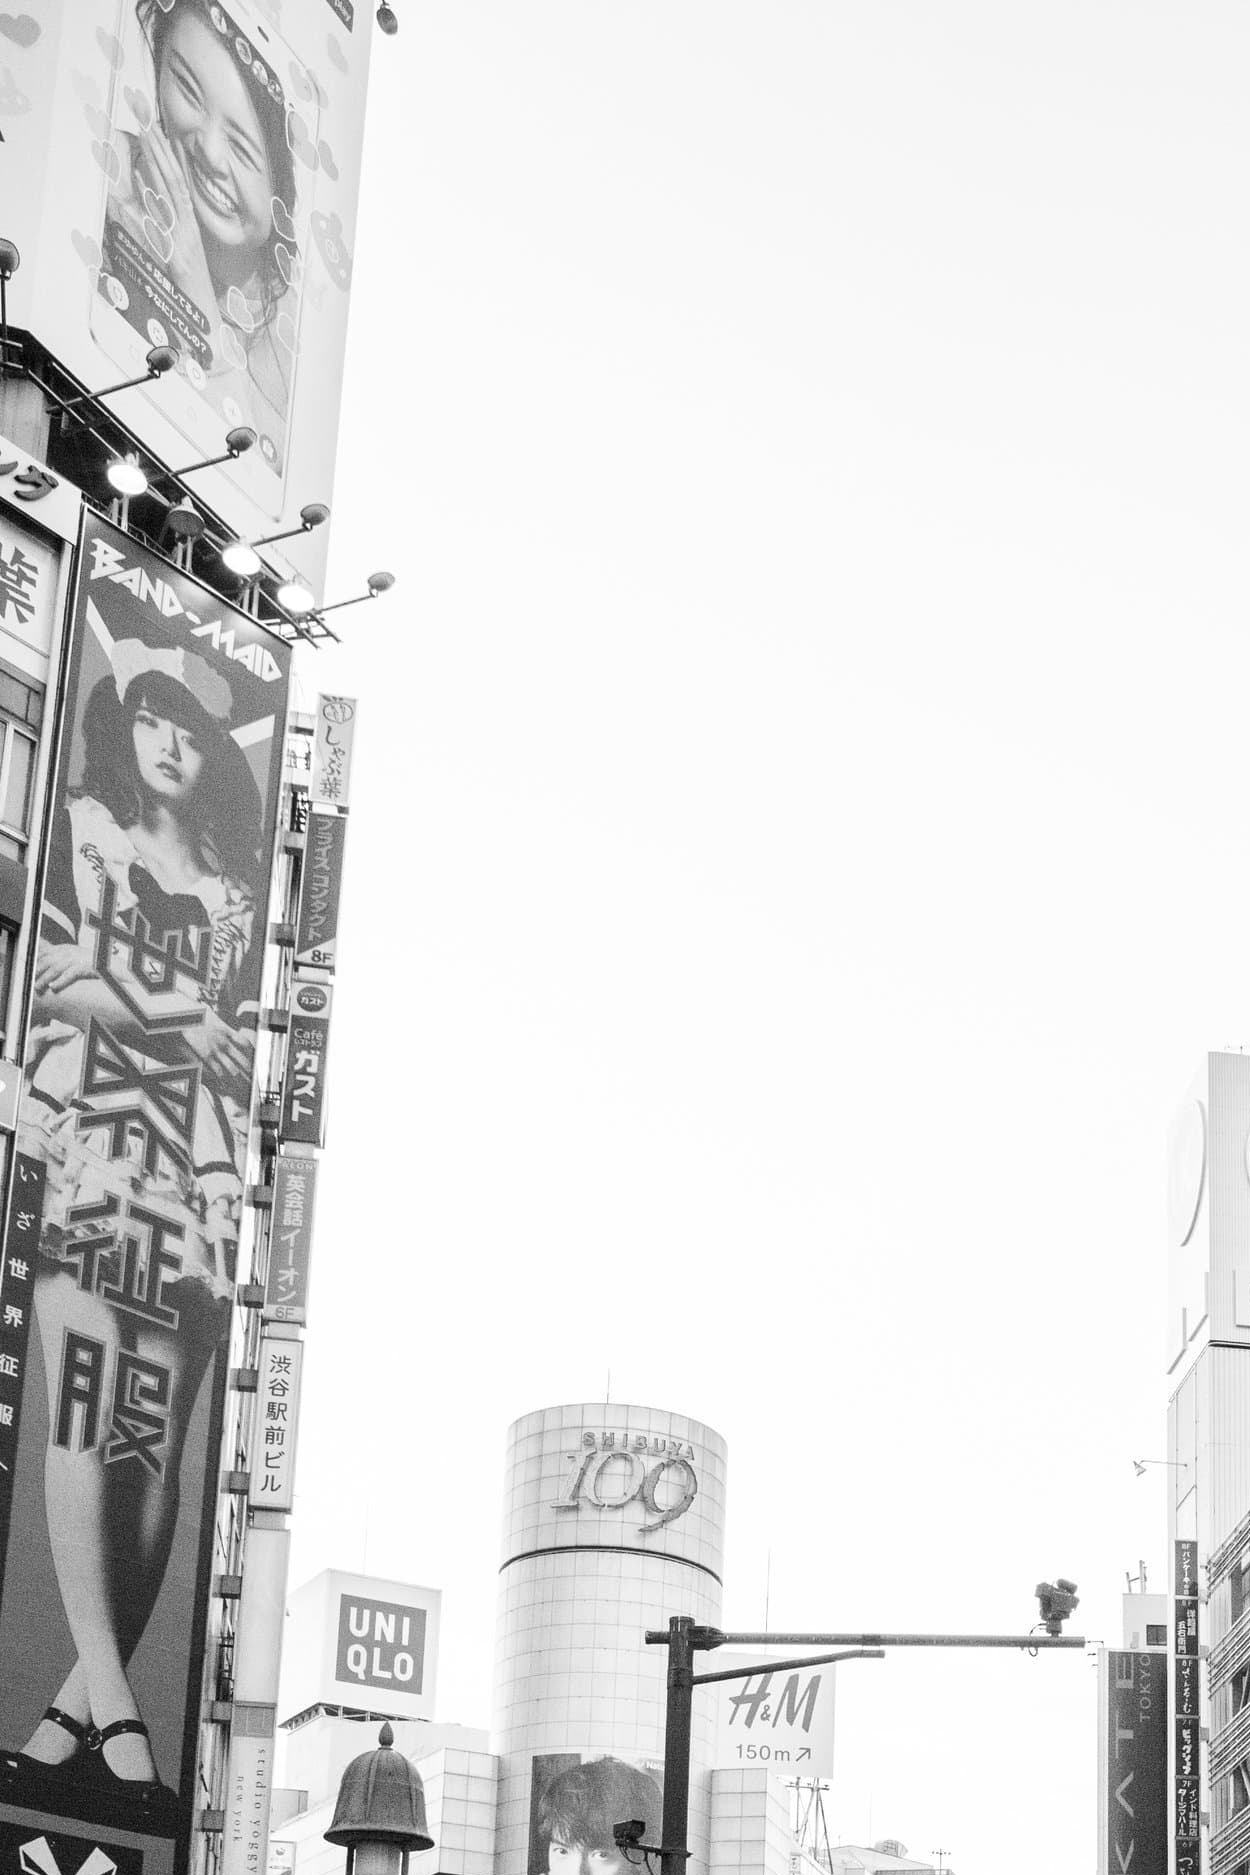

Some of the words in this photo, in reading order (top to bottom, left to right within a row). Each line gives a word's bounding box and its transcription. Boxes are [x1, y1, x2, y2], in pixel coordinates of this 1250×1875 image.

[311, 950, 333, 964] 8F
[291, 1049, 321, 1123] ガスト
[259, 1353, 293, 1494] 渋谷駅前ビル
[582, 1431, 695, 1461] SHIBUYA
[551, 1447, 698, 1533] 109
[349, 1606, 411, 1647] UNI
[346, 1643, 415, 1684] QLO
[1139, 1654, 1152, 1723] TOKYO
[728, 1672, 821, 1734] H&M
